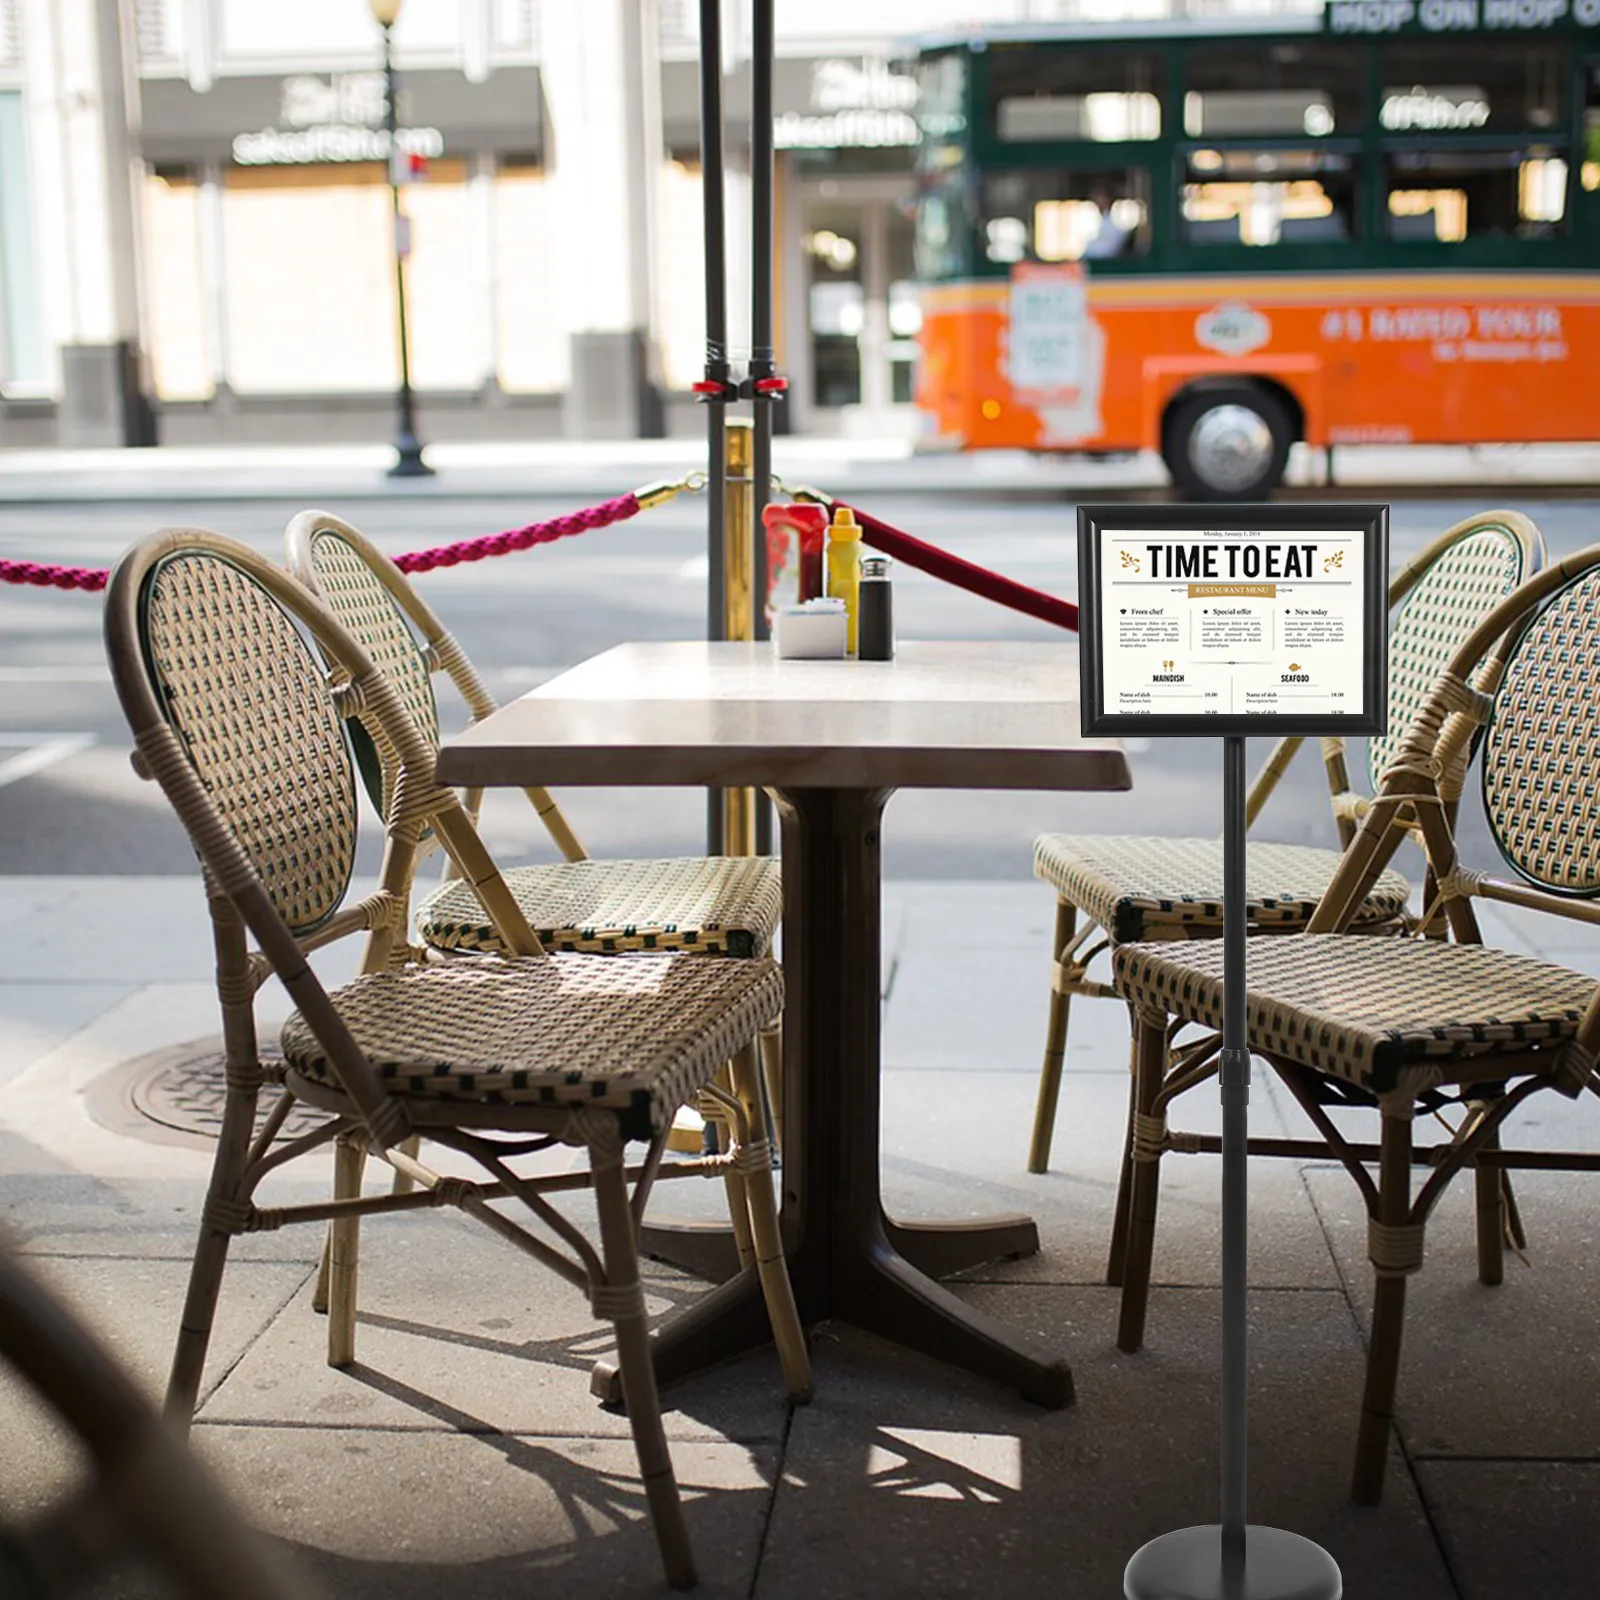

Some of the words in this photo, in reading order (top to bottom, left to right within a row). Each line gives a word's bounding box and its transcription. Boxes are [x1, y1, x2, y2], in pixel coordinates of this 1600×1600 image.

[1146, 545, 1219, 578] TIME
[1223, 545, 1260, 578] TO
[1265, 545, 1318, 578] EAT
[1195, 586, 1245, 594] RESTAURANT
[1246, 586, 1269, 594] MENU
[1212, 608, 1236, 616] Special
[1310, 608, 1328, 616] today
